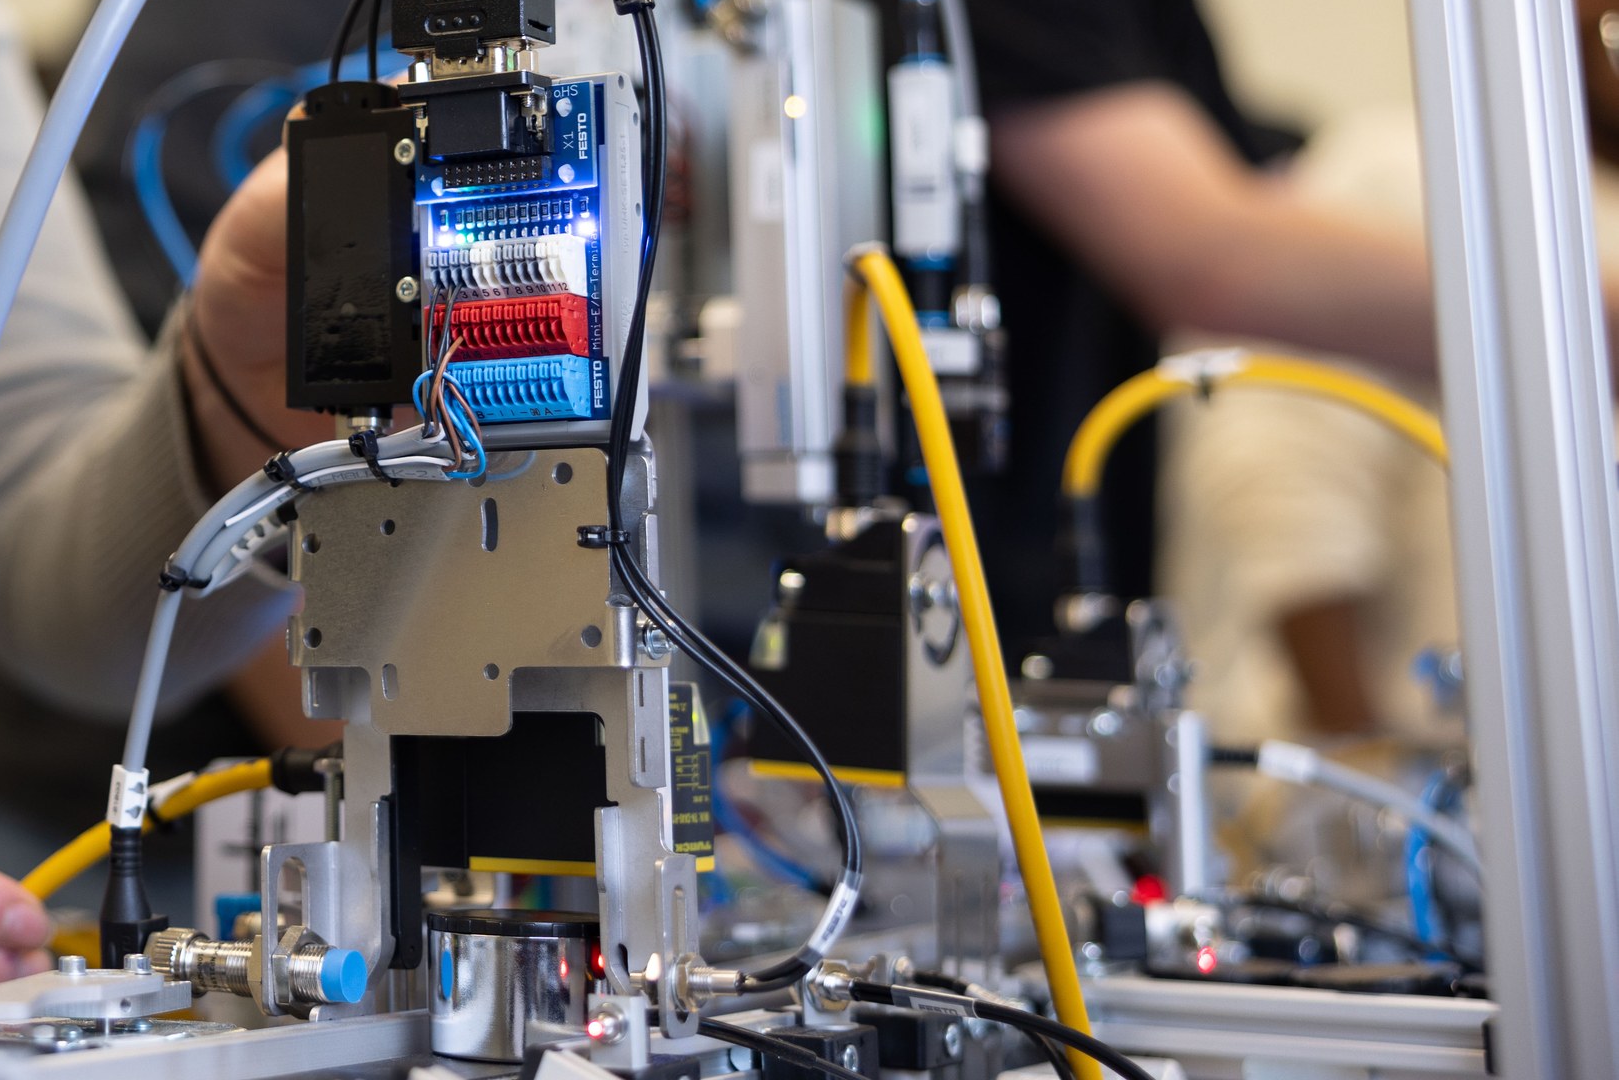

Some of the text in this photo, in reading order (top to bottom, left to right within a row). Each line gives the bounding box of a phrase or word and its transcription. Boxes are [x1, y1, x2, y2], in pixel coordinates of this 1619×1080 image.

[553, 84, 579, 98] oHS
[562, 130, 574, 150] X1
[577, 112, 589, 160] FESTO
[461, 291, 469, 299] 3
[471, 290, 479, 298] 4
[482, 289, 490, 297] 5
[493, 288, 501, 297] 6
[503, 287, 510, 296] 7
[514, 286, 523, 295] 8
[525, 285, 534, 294] 9
[536, 284, 547, 293] 10
[547, 283, 557, 292] 11
[557, 282, 569, 291] 12
[592, 360, 604, 409] FESTO
